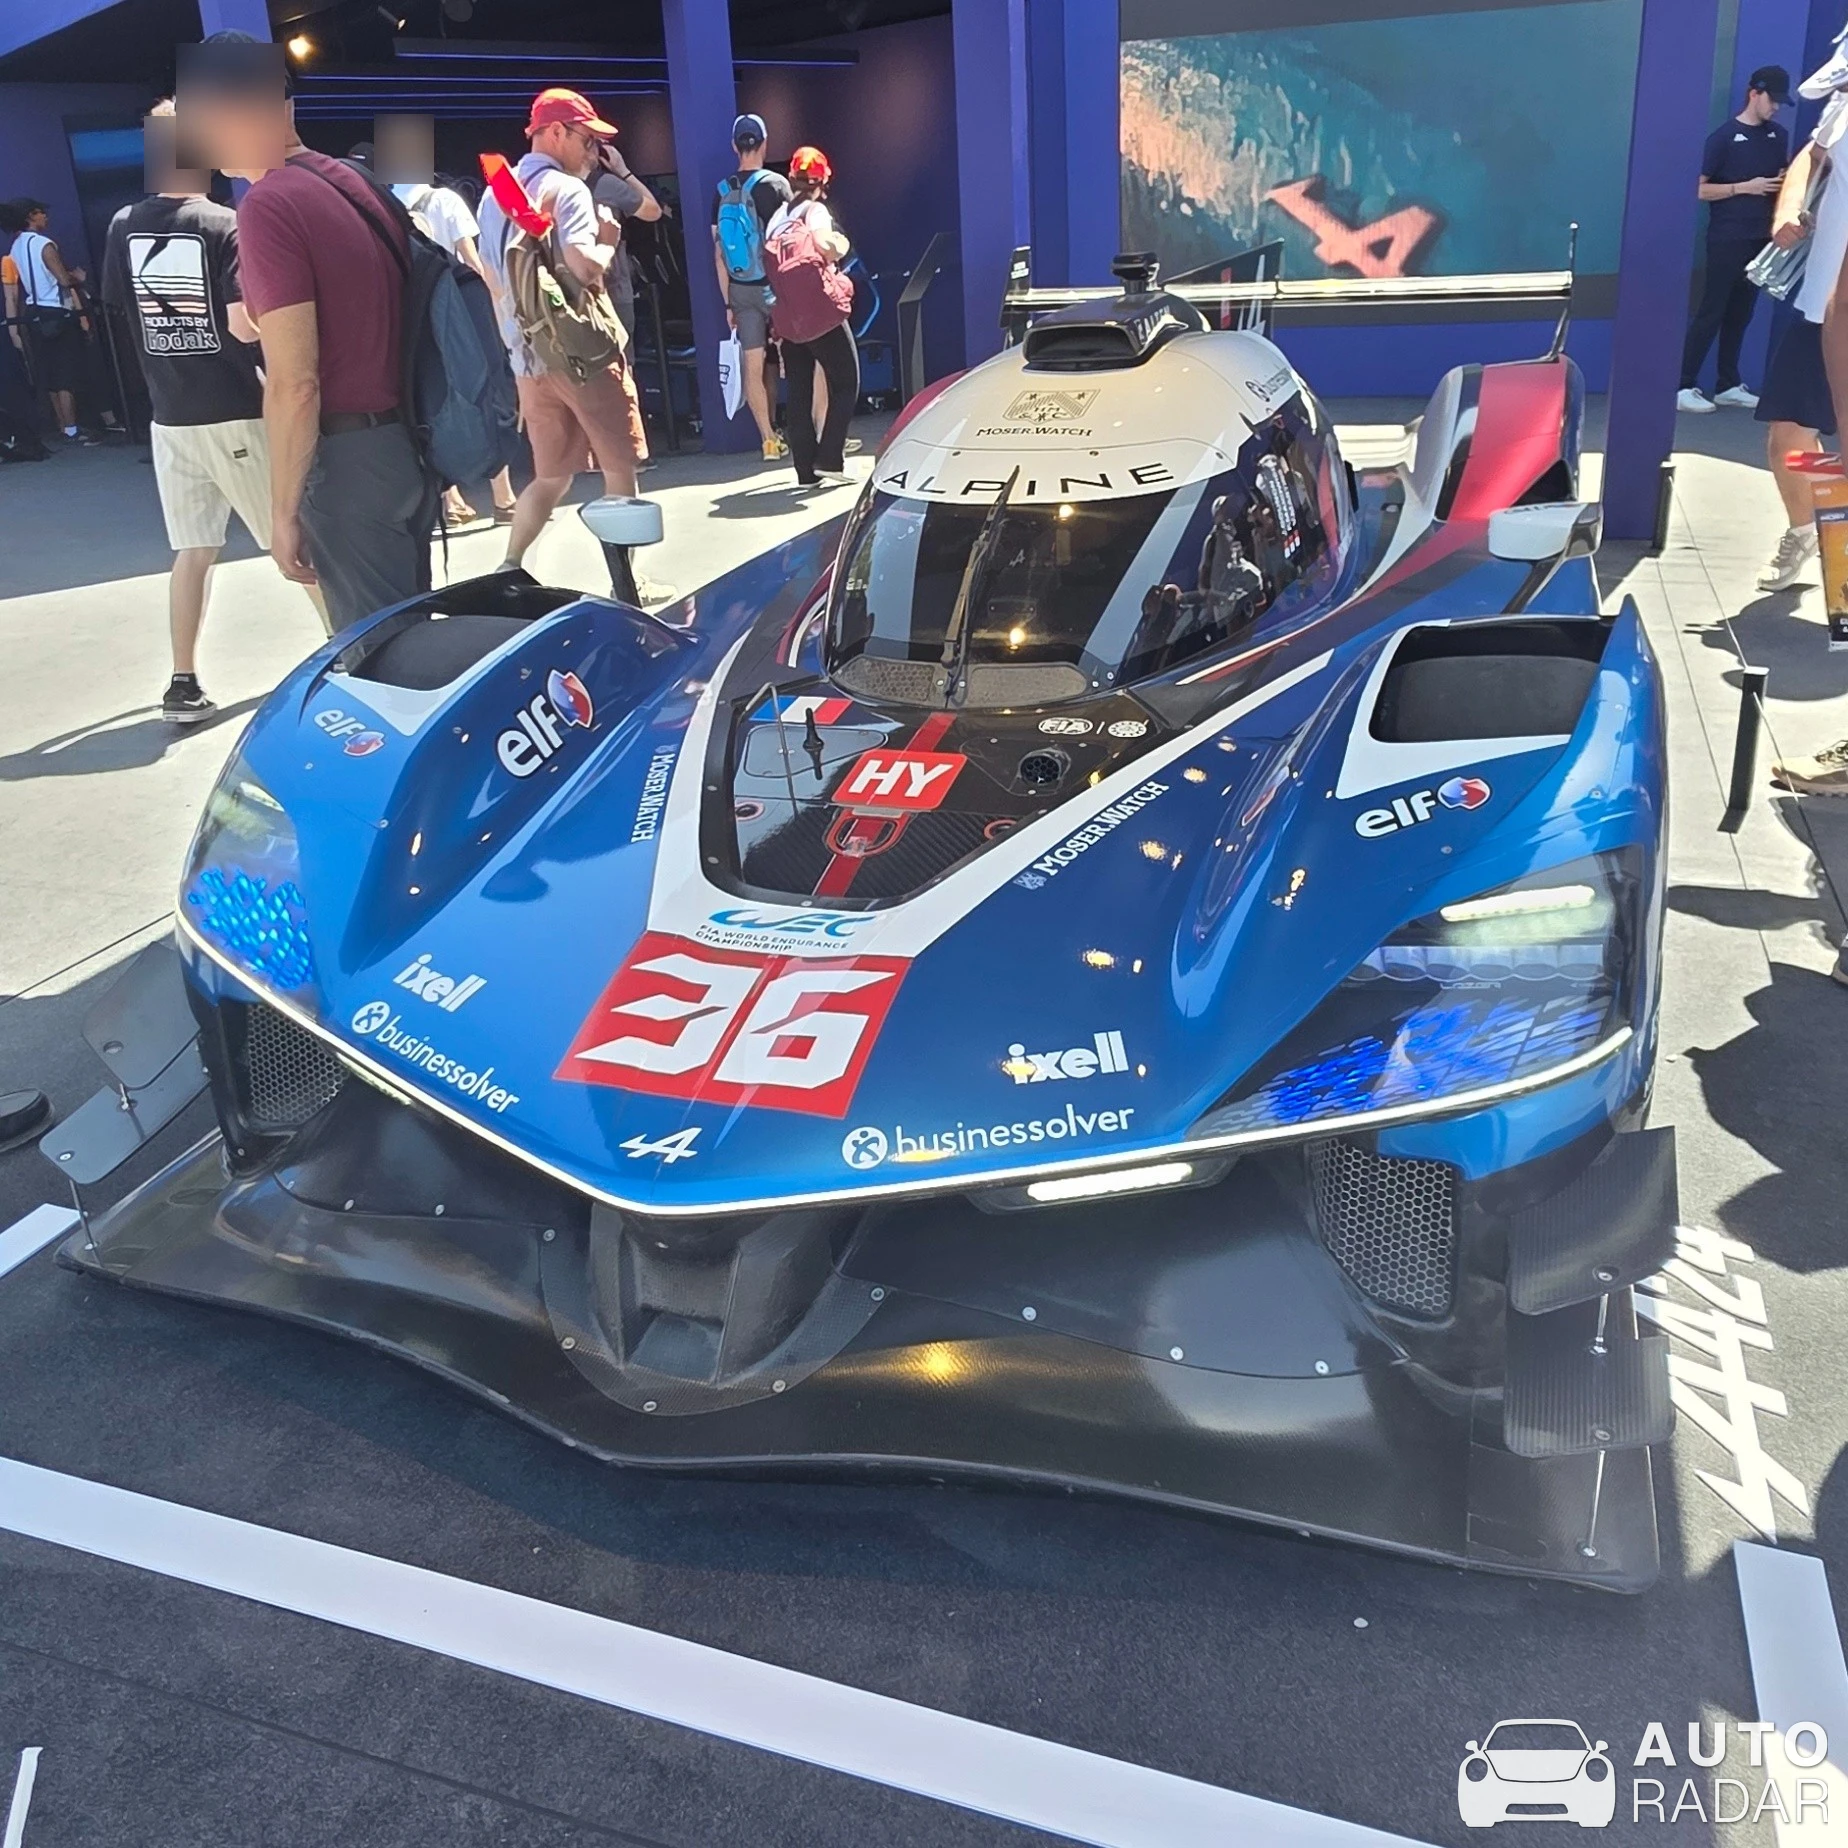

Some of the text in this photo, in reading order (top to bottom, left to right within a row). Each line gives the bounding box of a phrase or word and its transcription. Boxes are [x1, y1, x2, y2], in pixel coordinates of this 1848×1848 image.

[194, 316, 209, 328] BY
[976, 427, 1093, 437] MOSER.WATCH
[882, 463, 1175, 497] ALPINE
[314, 708, 359, 738] elf
[498, 695, 563, 777] elf
[631, 753, 676, 843] MOSER.WATCH
[849, 759, 953, 798] HY
[1033, 781, 1169, 876] MOSER.WATCH
[1355, 791, 1435, 837] elf
[695, 931, 793, 951] CHAMPIONSHIP
[700, 924, 848, 949] FIA WORLD ENDURANCE
[708, 909, 876, 938] WEC
[393, 953, 487, 1013] ixell
[575, 953, 896, 1088] 36
[376, 1016, 520, 1114] businessolver
[1006, 1030, 1129, 1084] ixell
[895, 1104, 1134, 1158] businessolver
